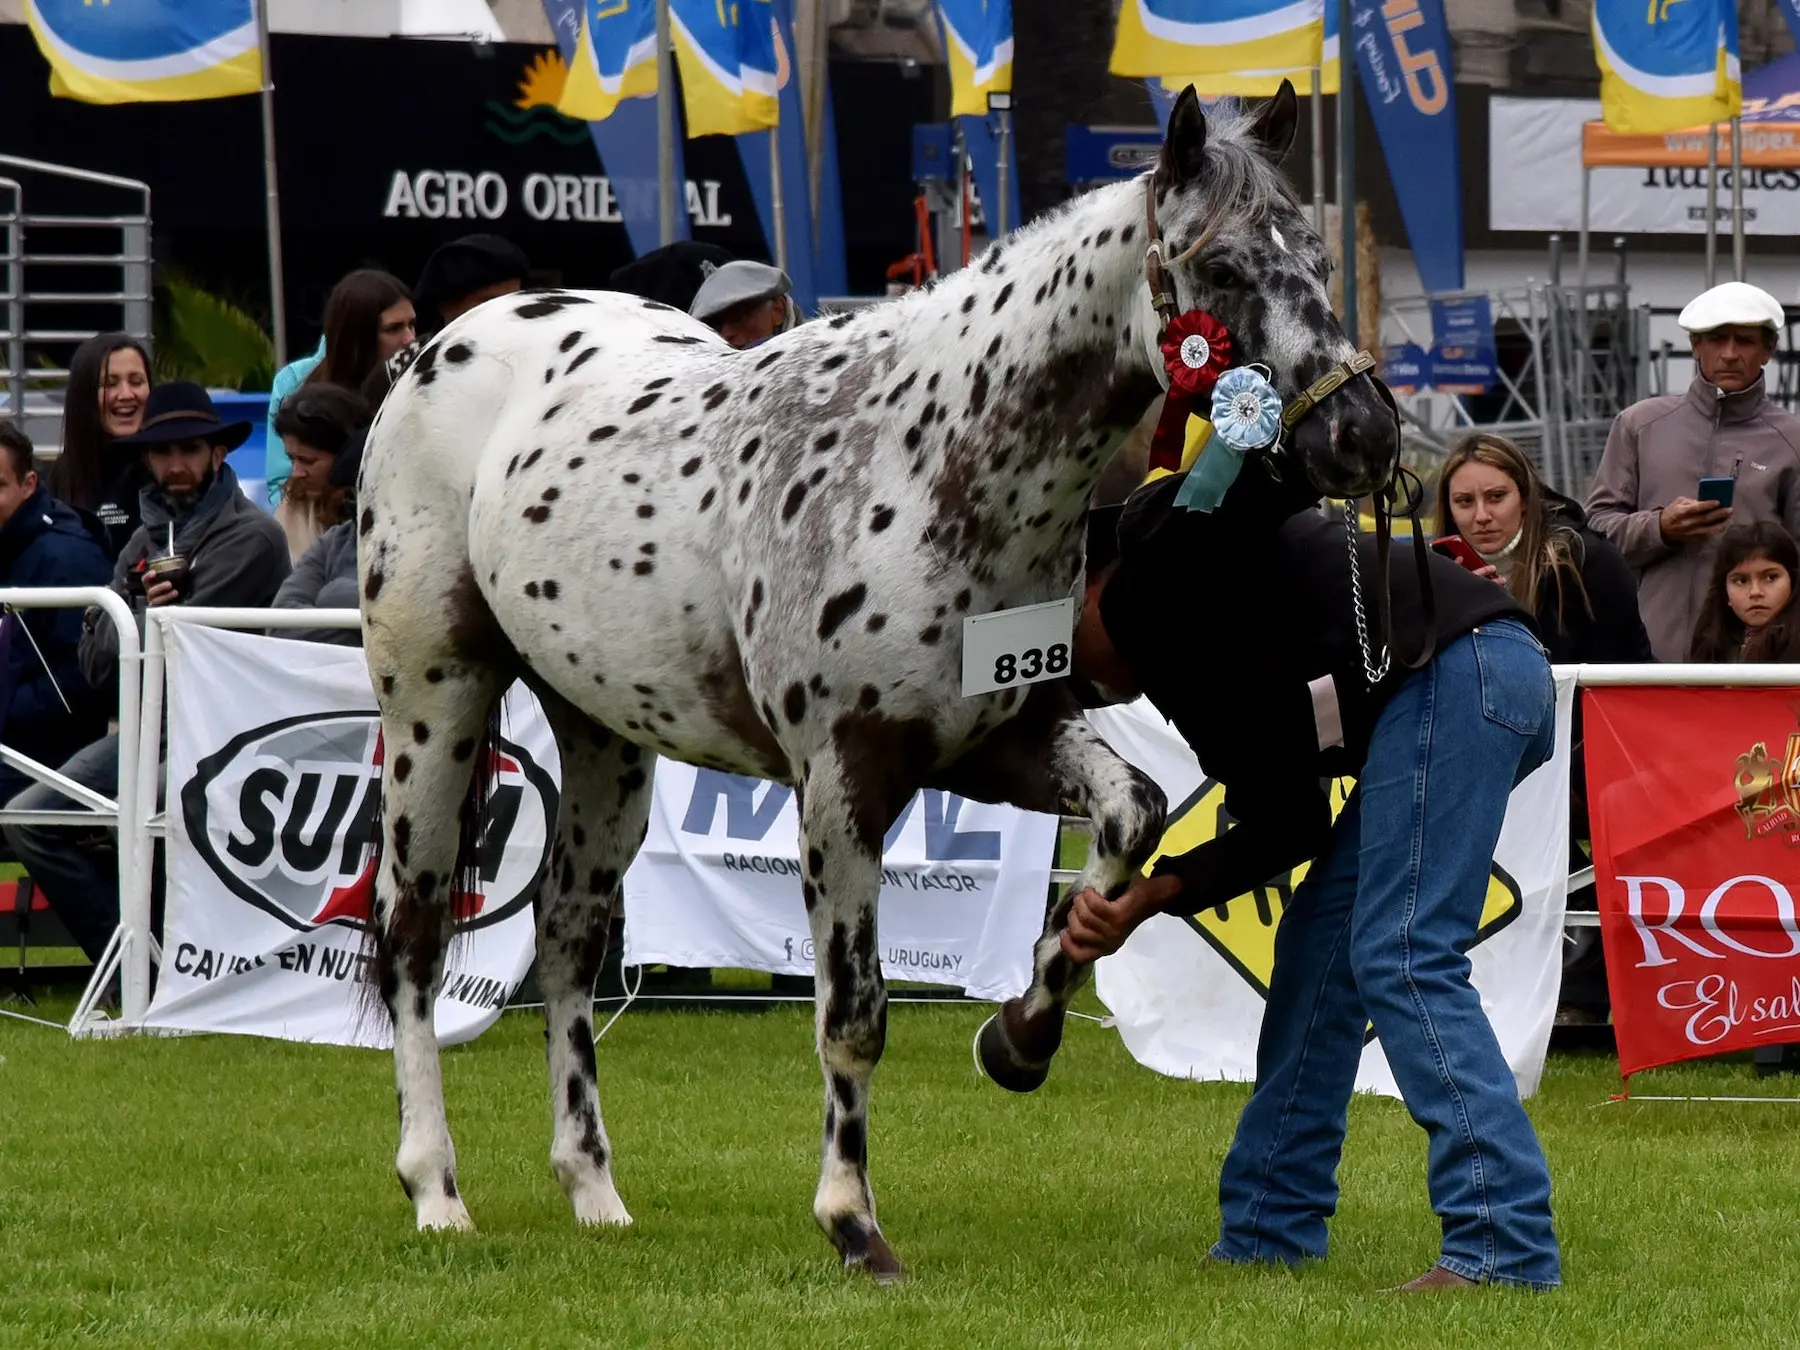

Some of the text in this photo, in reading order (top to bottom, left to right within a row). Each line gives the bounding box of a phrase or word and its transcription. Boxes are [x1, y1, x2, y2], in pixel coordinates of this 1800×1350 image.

[384, 170, 732, 227] AGRO ORIEAL
[994, 643, 1069, 684] 838
[904, 871, 982, 892] VALOR
[888, 948, 963, 971] URUGUAY
[1657, 974, 1748, 1045] El
